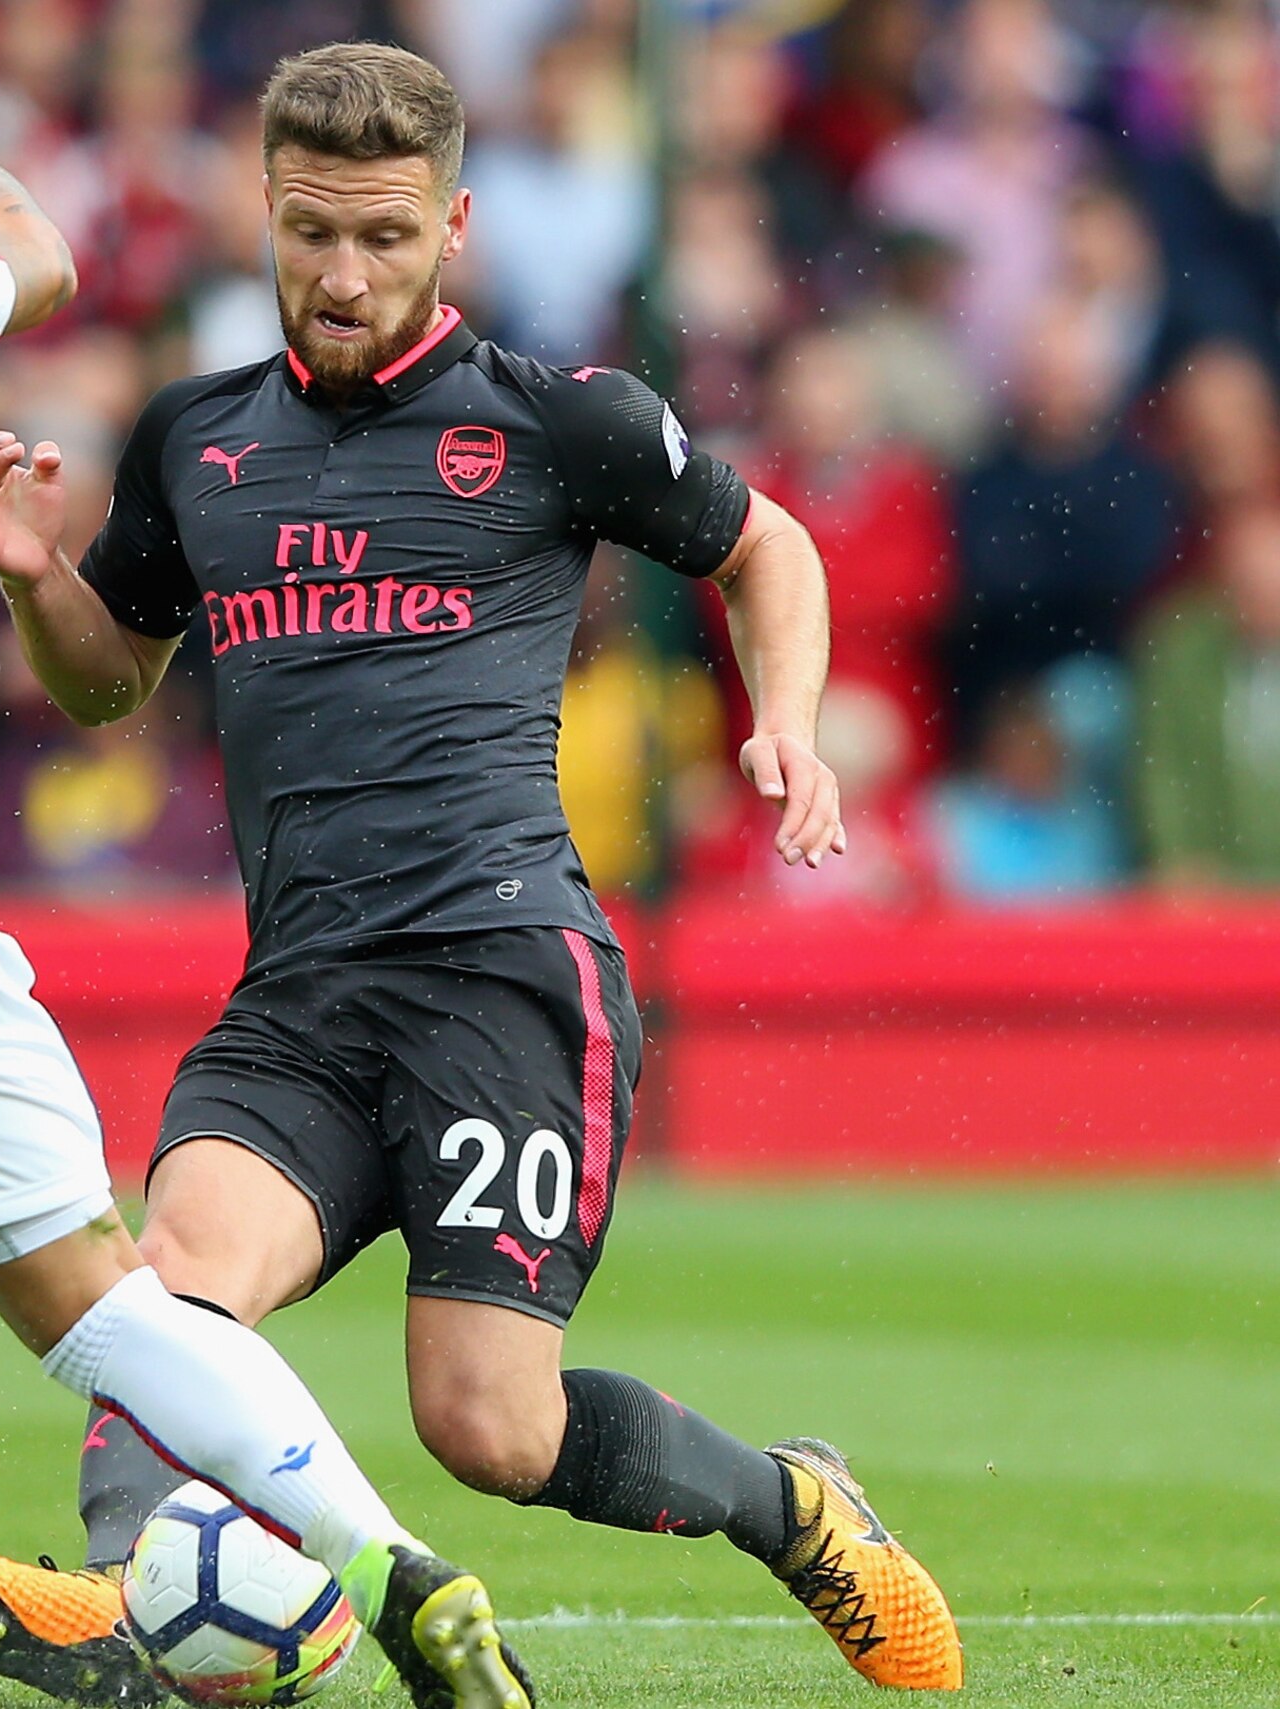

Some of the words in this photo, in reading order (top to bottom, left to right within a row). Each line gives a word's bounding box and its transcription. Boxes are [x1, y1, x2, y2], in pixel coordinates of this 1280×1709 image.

[275, 522, 369, 576] Fly
[203, 572, 474, 657] Emirates
[435, 1117, 574, 1241] 20
